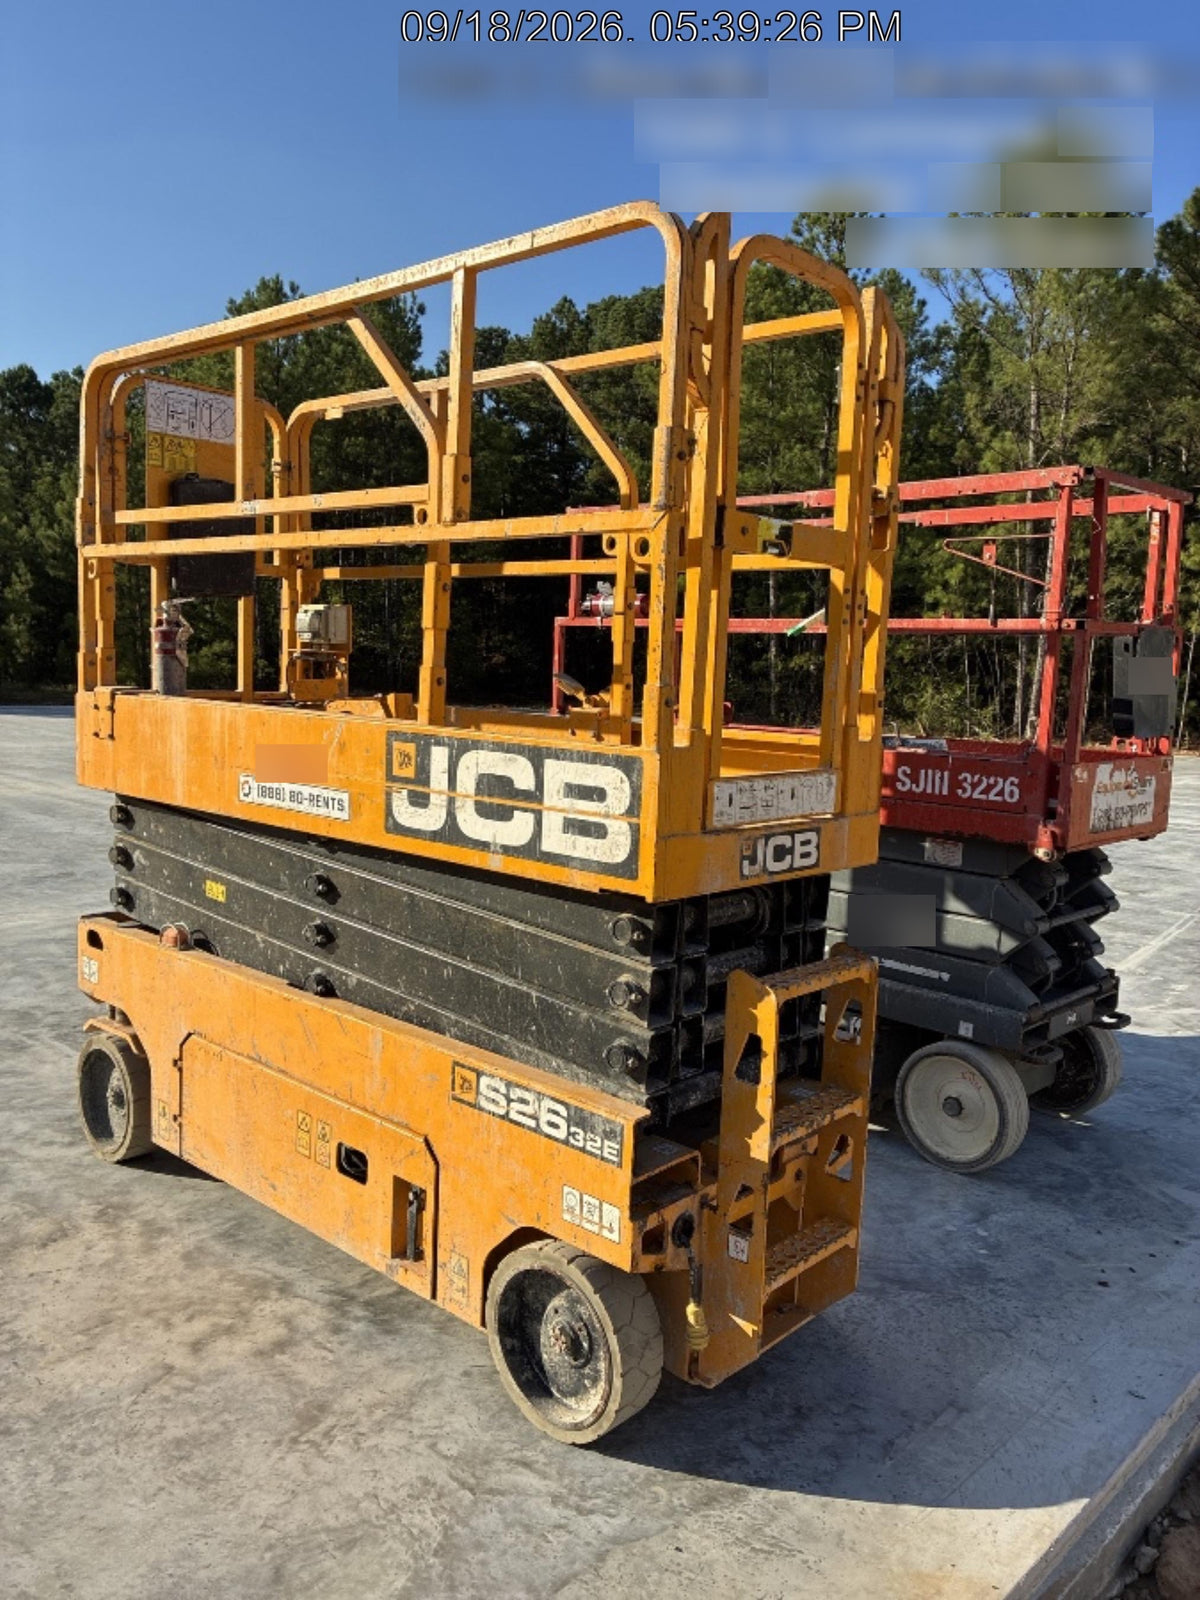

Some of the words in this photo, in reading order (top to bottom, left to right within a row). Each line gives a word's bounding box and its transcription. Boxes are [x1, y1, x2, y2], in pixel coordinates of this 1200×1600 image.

[391, 746, 632, 863] JCB
[957, 772, 1020, 803] 3226
[741, 830, 819, 876] JCB
